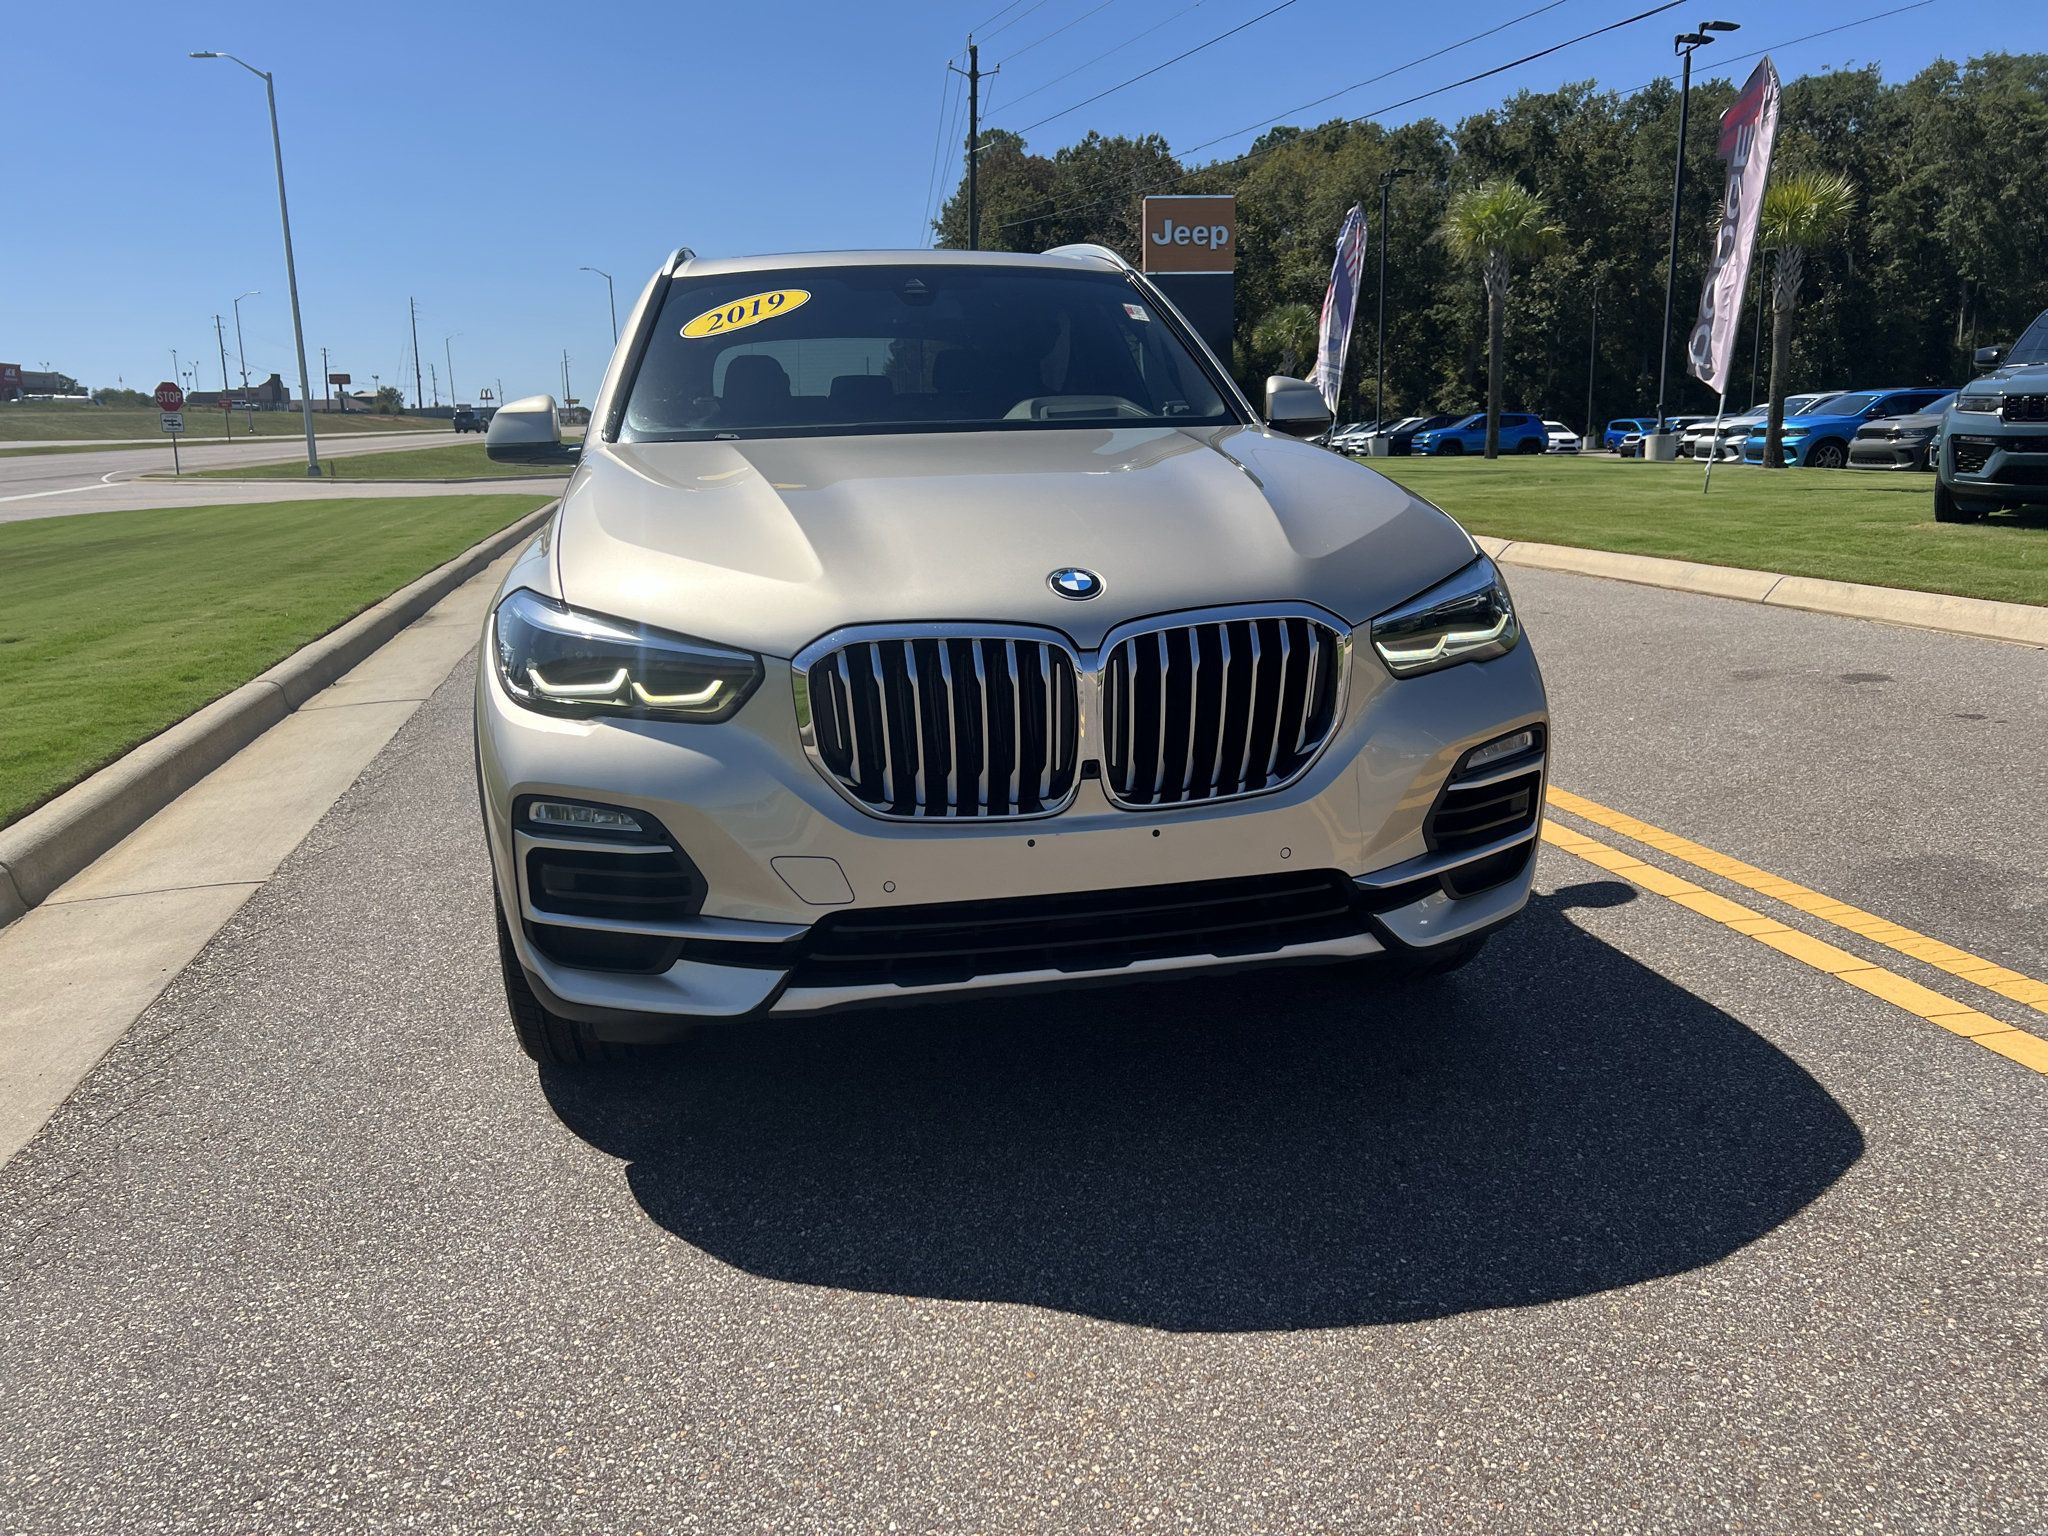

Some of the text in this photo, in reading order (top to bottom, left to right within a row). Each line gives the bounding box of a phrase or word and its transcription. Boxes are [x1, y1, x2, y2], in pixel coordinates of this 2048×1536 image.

[1152, 219, 1229, 250] Jeep
[706, 293, 785, 332] 2019
[157, 391, 182, 403] STOP
